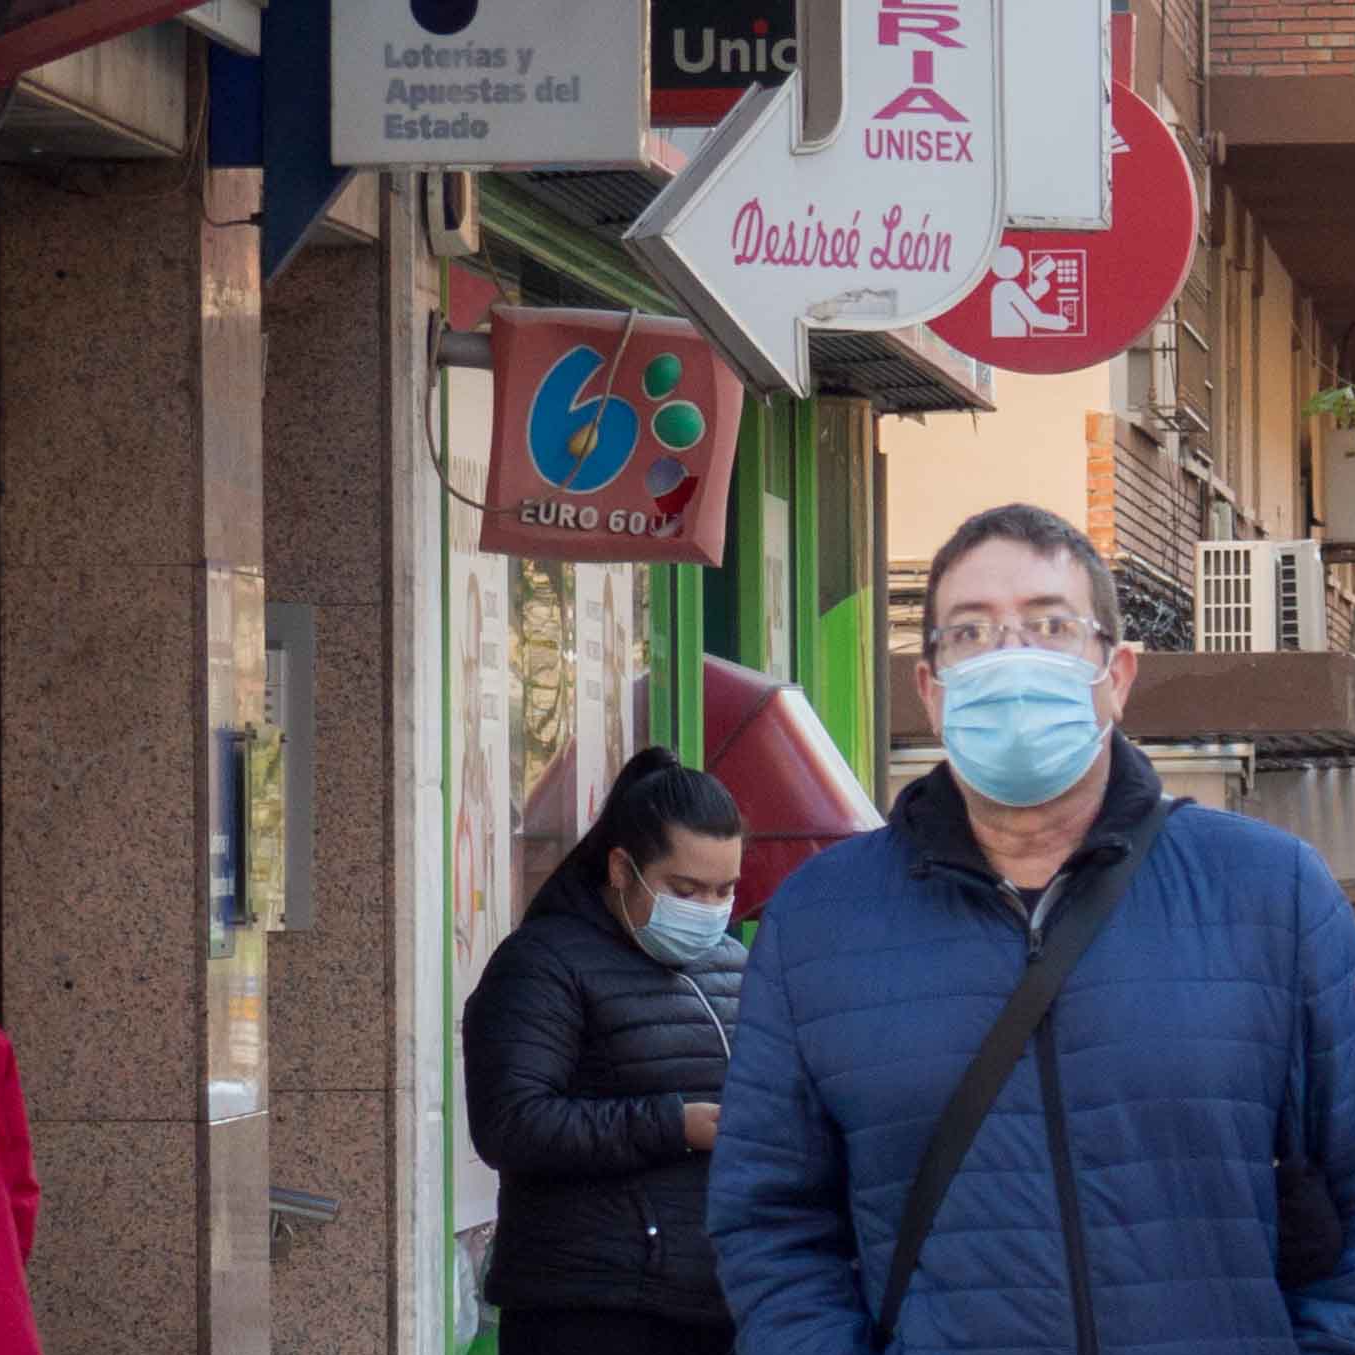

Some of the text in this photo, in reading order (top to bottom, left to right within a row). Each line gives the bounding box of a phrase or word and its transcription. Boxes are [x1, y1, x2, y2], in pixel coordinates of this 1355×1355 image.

[384, 40, 534, 75] Loterías y
[385, 75, 580, 110] Apuestas del
[384, 112, 489, 140] Estado
[865, 128, 973, 162] UNISEX
[731, 198, 952, 273] Desireé León
[527, 344, 641, 494] 6
[520, 498, 598, 530] EURO
